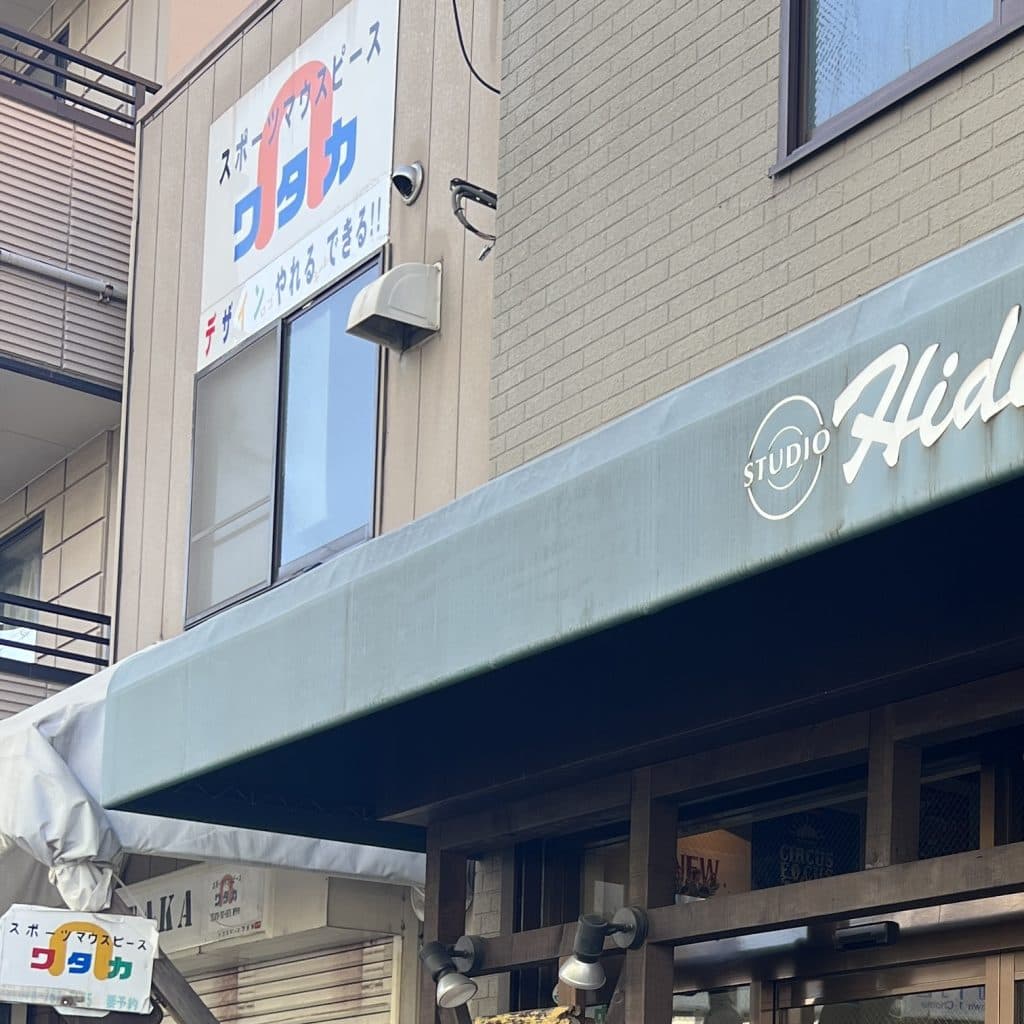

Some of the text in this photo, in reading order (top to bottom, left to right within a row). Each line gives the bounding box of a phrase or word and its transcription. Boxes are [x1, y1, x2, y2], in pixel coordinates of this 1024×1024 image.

[218, 21, 381, 185] スポーツマウスピース
[233, 115, 358, 263] ワタカ
[743, 425, 832, 488] STUDIO
[30, 947, 133, 980] ワタカ
